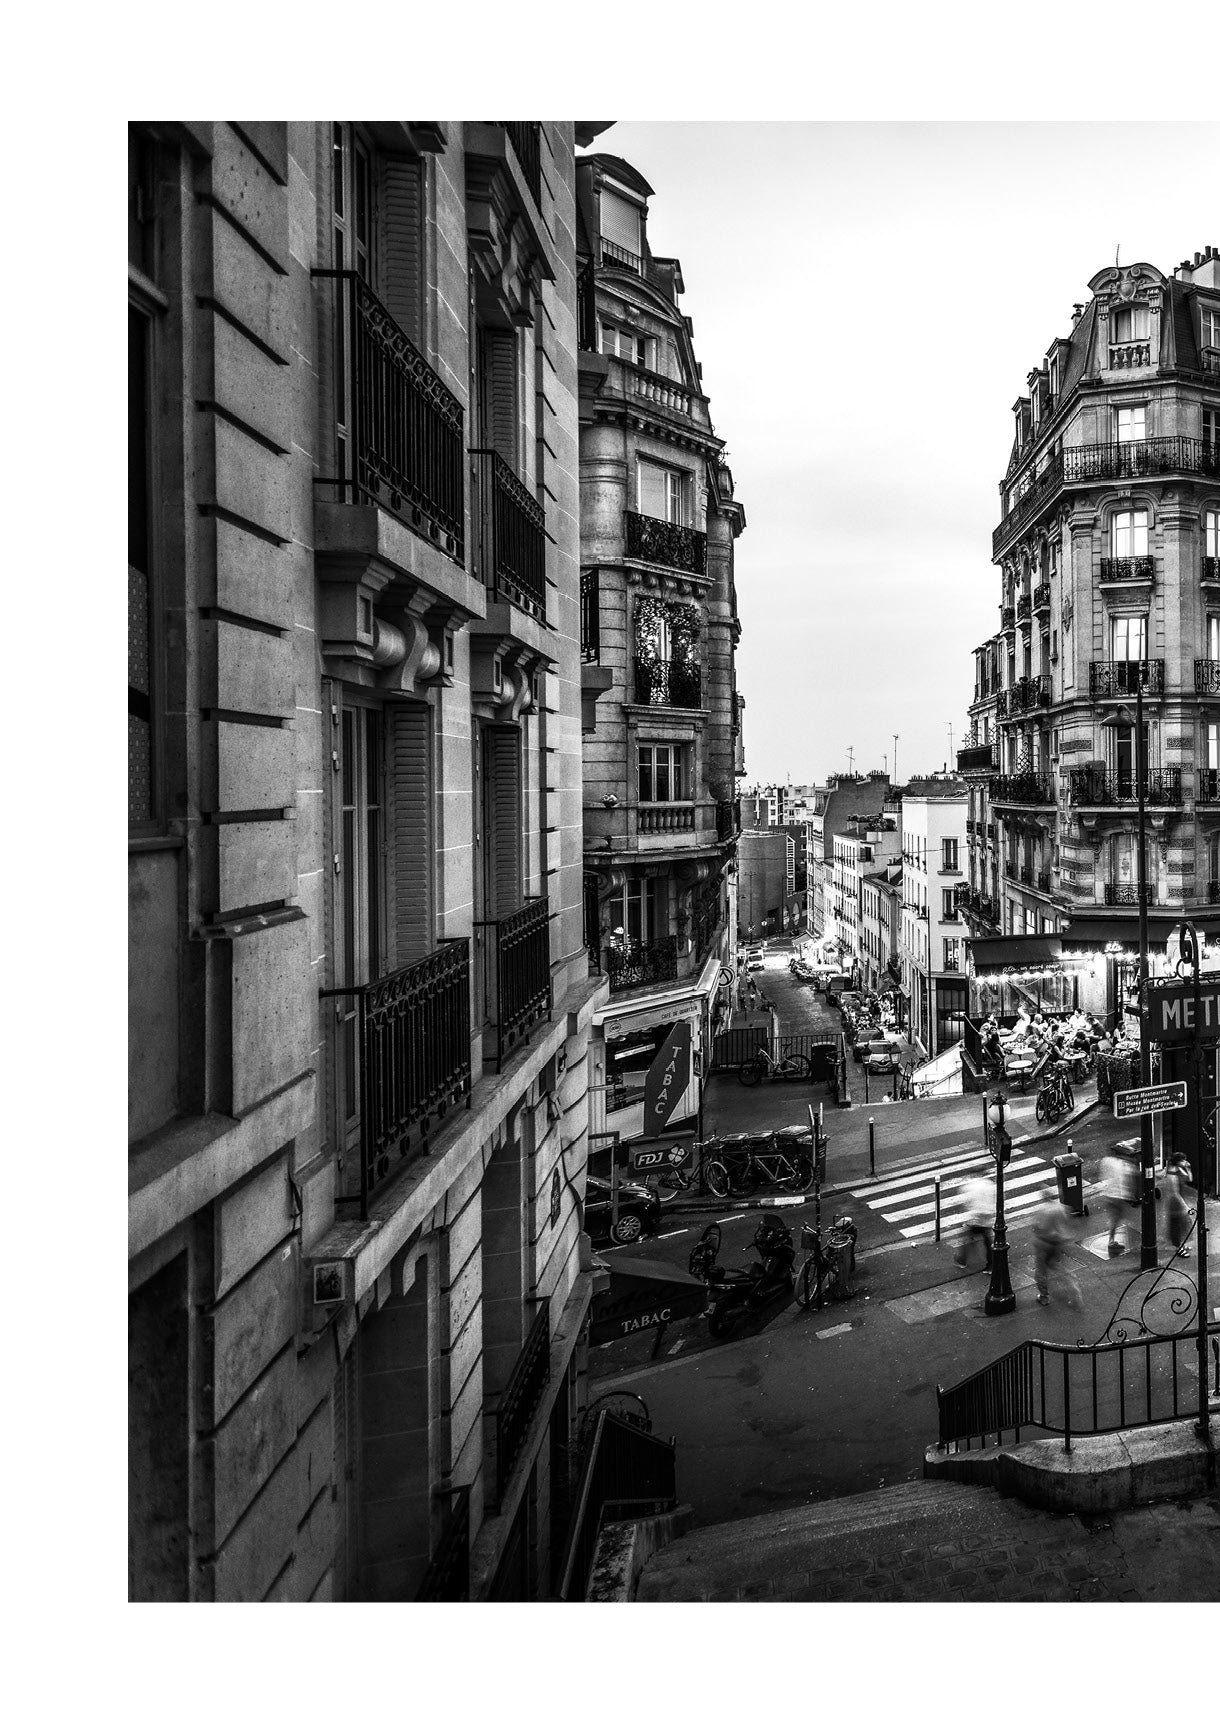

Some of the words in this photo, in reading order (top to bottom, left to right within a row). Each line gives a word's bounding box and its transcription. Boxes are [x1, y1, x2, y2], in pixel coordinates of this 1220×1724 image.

[654, 1046, 683, 1114] TABAC
[1140, 1089, 1167, 1098] Montmartre
[1142, 1095, 1170, 1104] Montmartre
[637, 1151, 664, 1166] FDJ
[621, 1308, 672, 1334] TABAC
